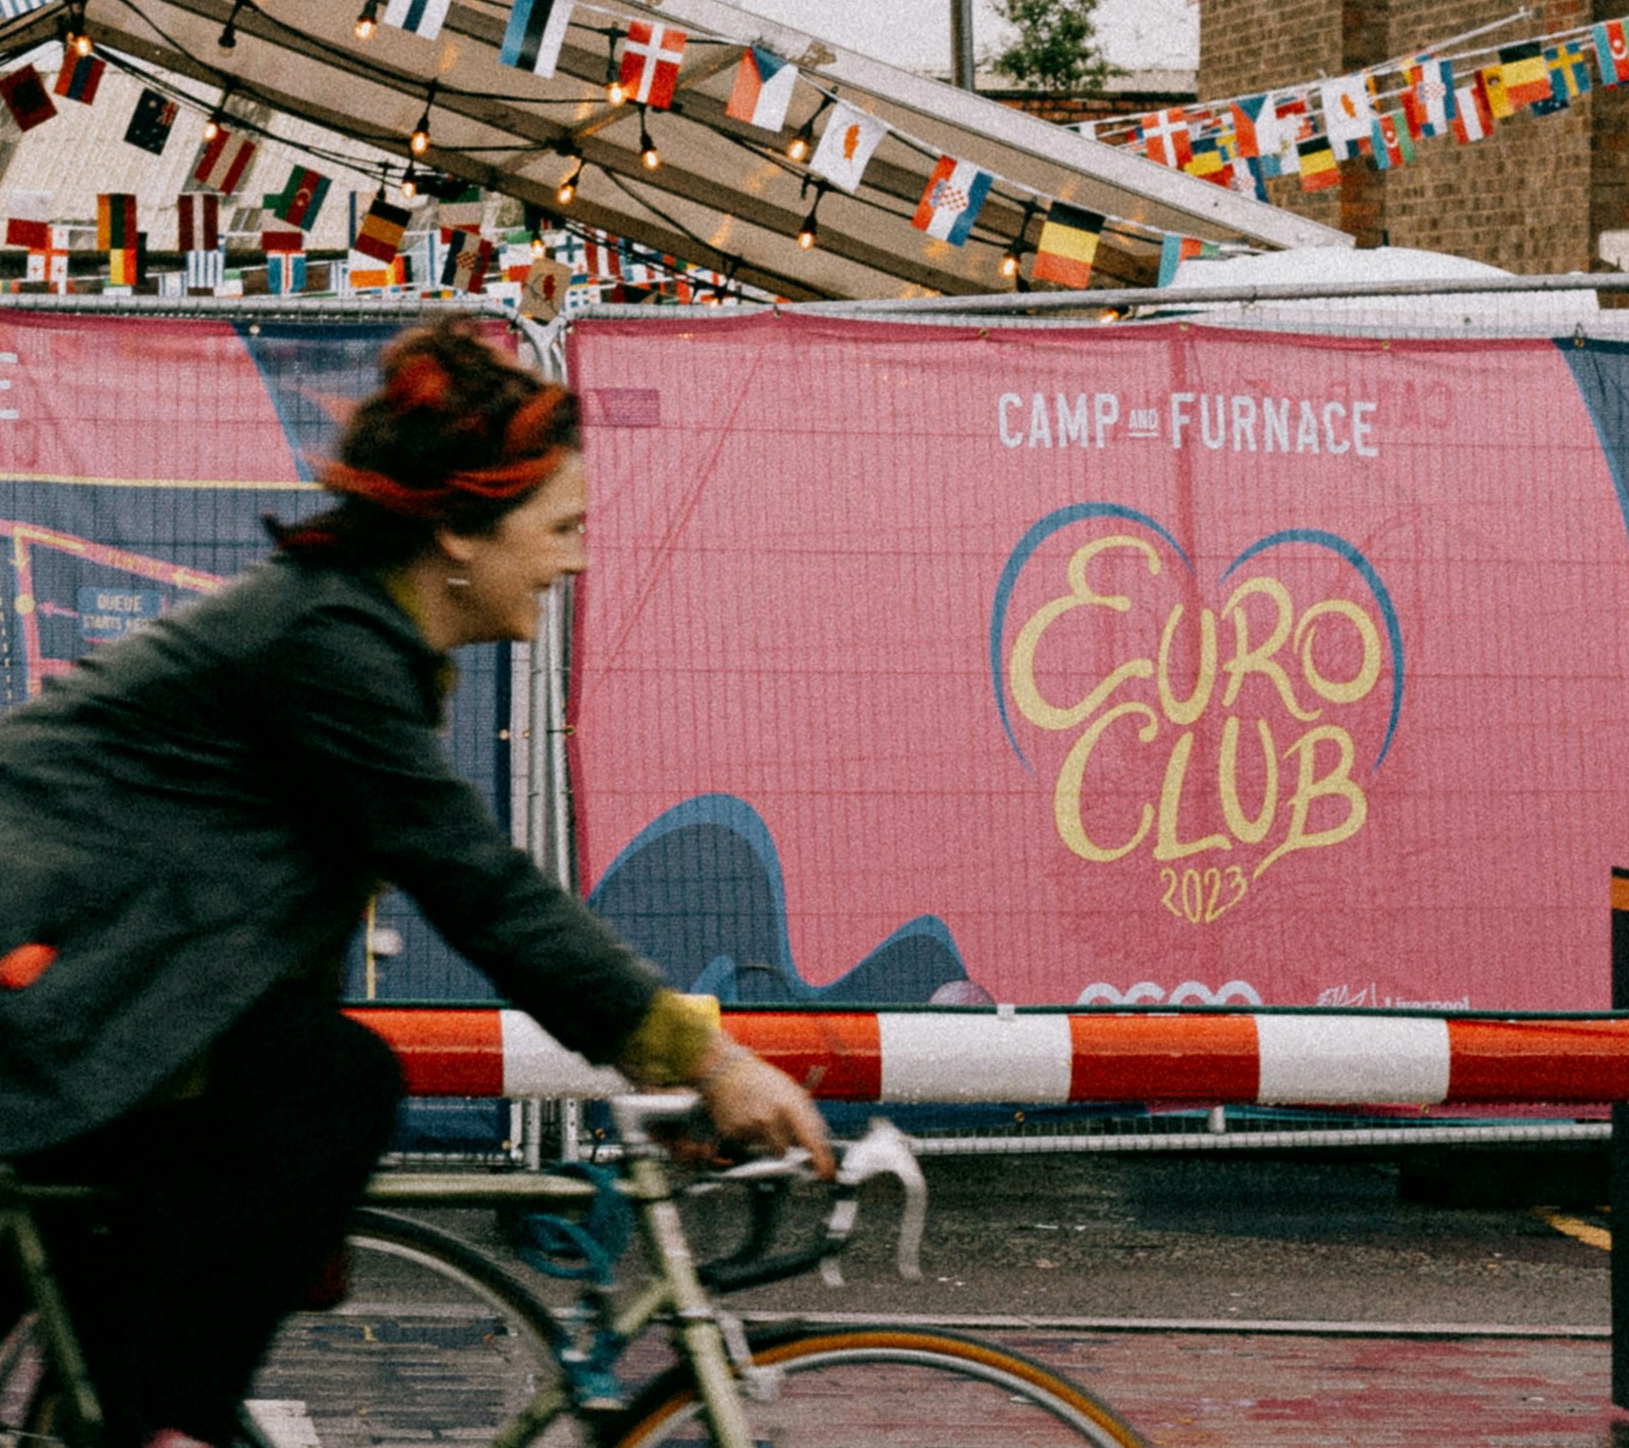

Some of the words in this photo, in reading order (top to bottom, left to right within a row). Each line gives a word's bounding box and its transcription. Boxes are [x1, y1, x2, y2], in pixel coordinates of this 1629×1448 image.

[998, 392, 1120, 449] CAMP
[1128, 408, 1160, 430] AND
[1170, 392, 1380, 457] FURNACE
[82, 615, 122, 630] STARTS
[96, 594, 142, 612] QUEUE
[1009, 534, 1382, 730] EURO
[1054, 701, 1368, 879] CLUB
[1160, 864, 1248, 924] 2023
